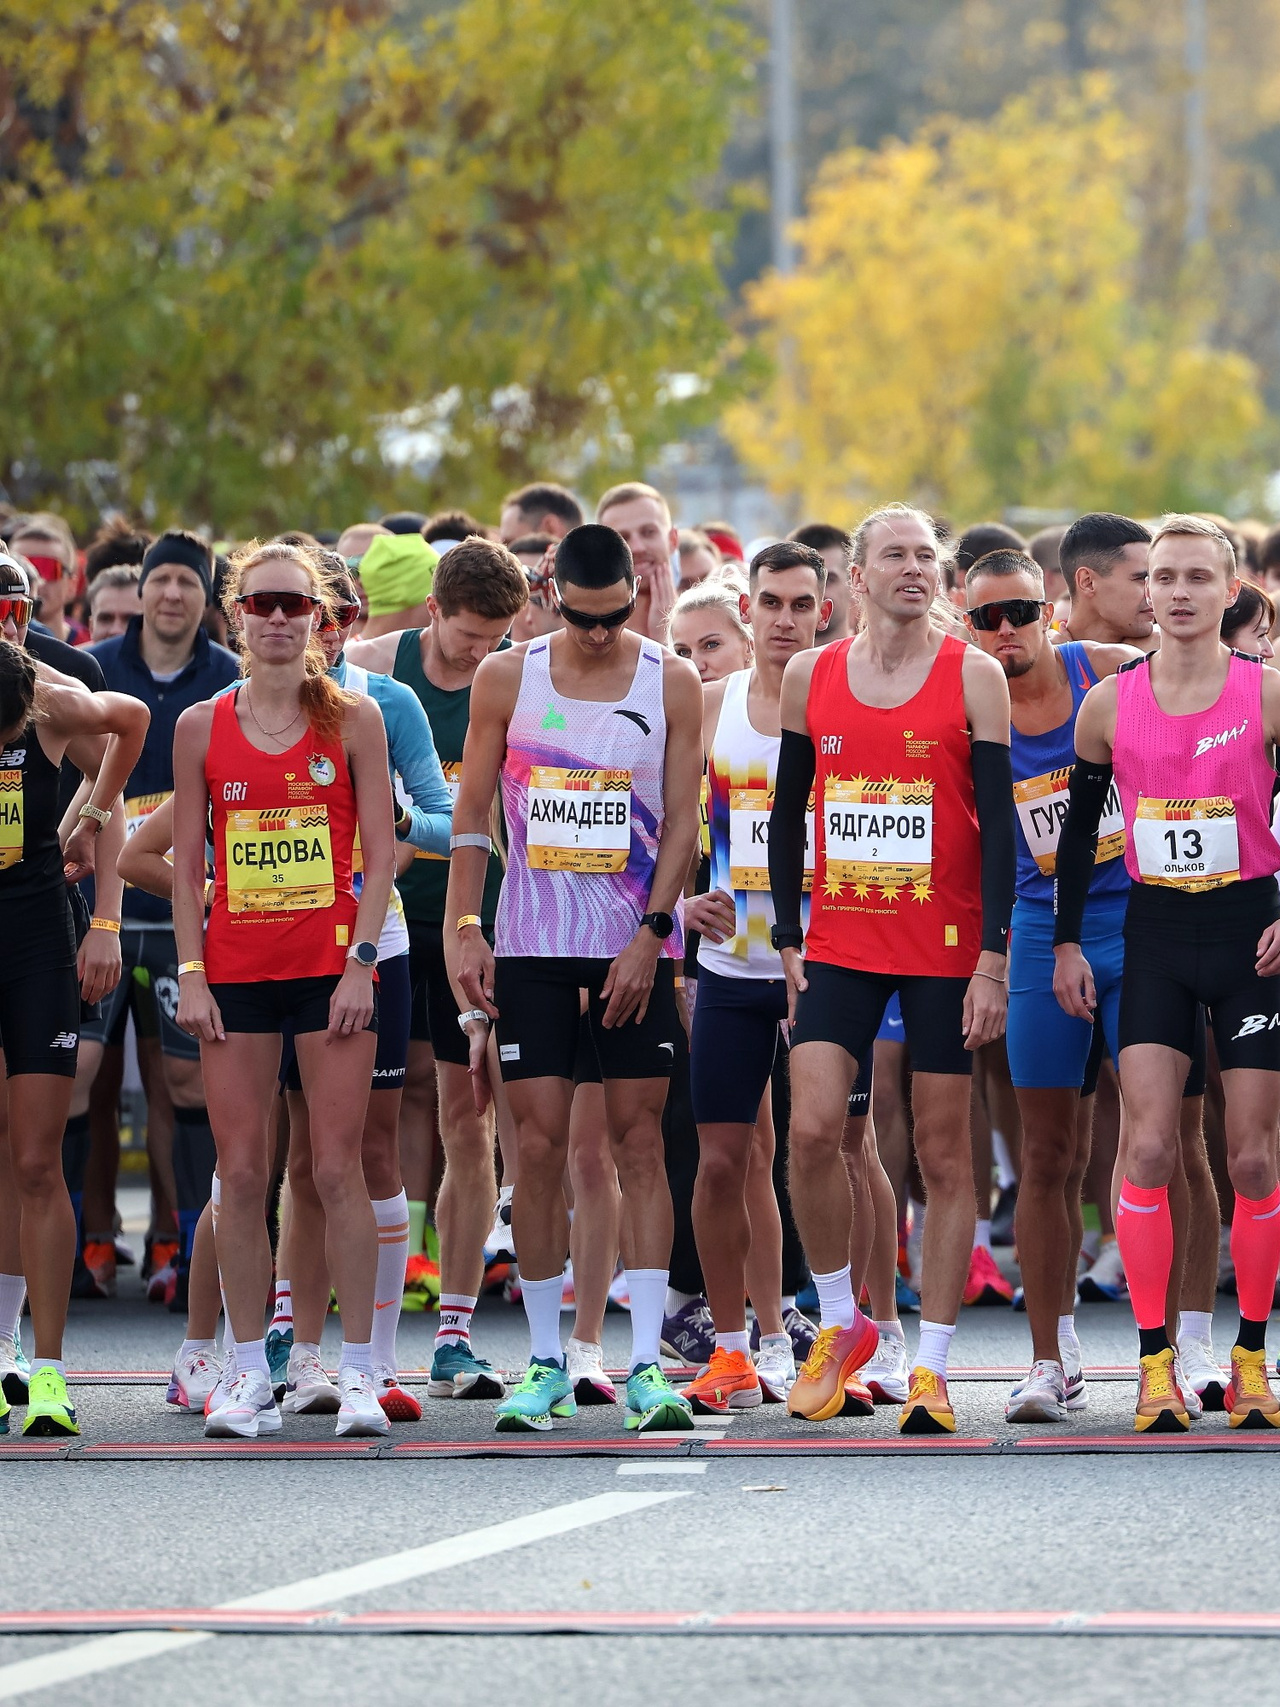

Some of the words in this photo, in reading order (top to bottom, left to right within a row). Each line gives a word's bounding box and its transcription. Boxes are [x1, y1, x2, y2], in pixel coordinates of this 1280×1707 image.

[530, 798, 627, 830] АХМАДЕЕВ
[830, 812, 926, 842] ЯДГАРОВ
[574, 834, 579, 843] 1
[1164, 829, 1203, 860] 13
[233, 837, 326, 871] СЕДОВА
[872, 848, 878, 857] 2
[1164, 862, 1205, 873] ОЛЬКОВ
[272, 874, 284, 883] 35
